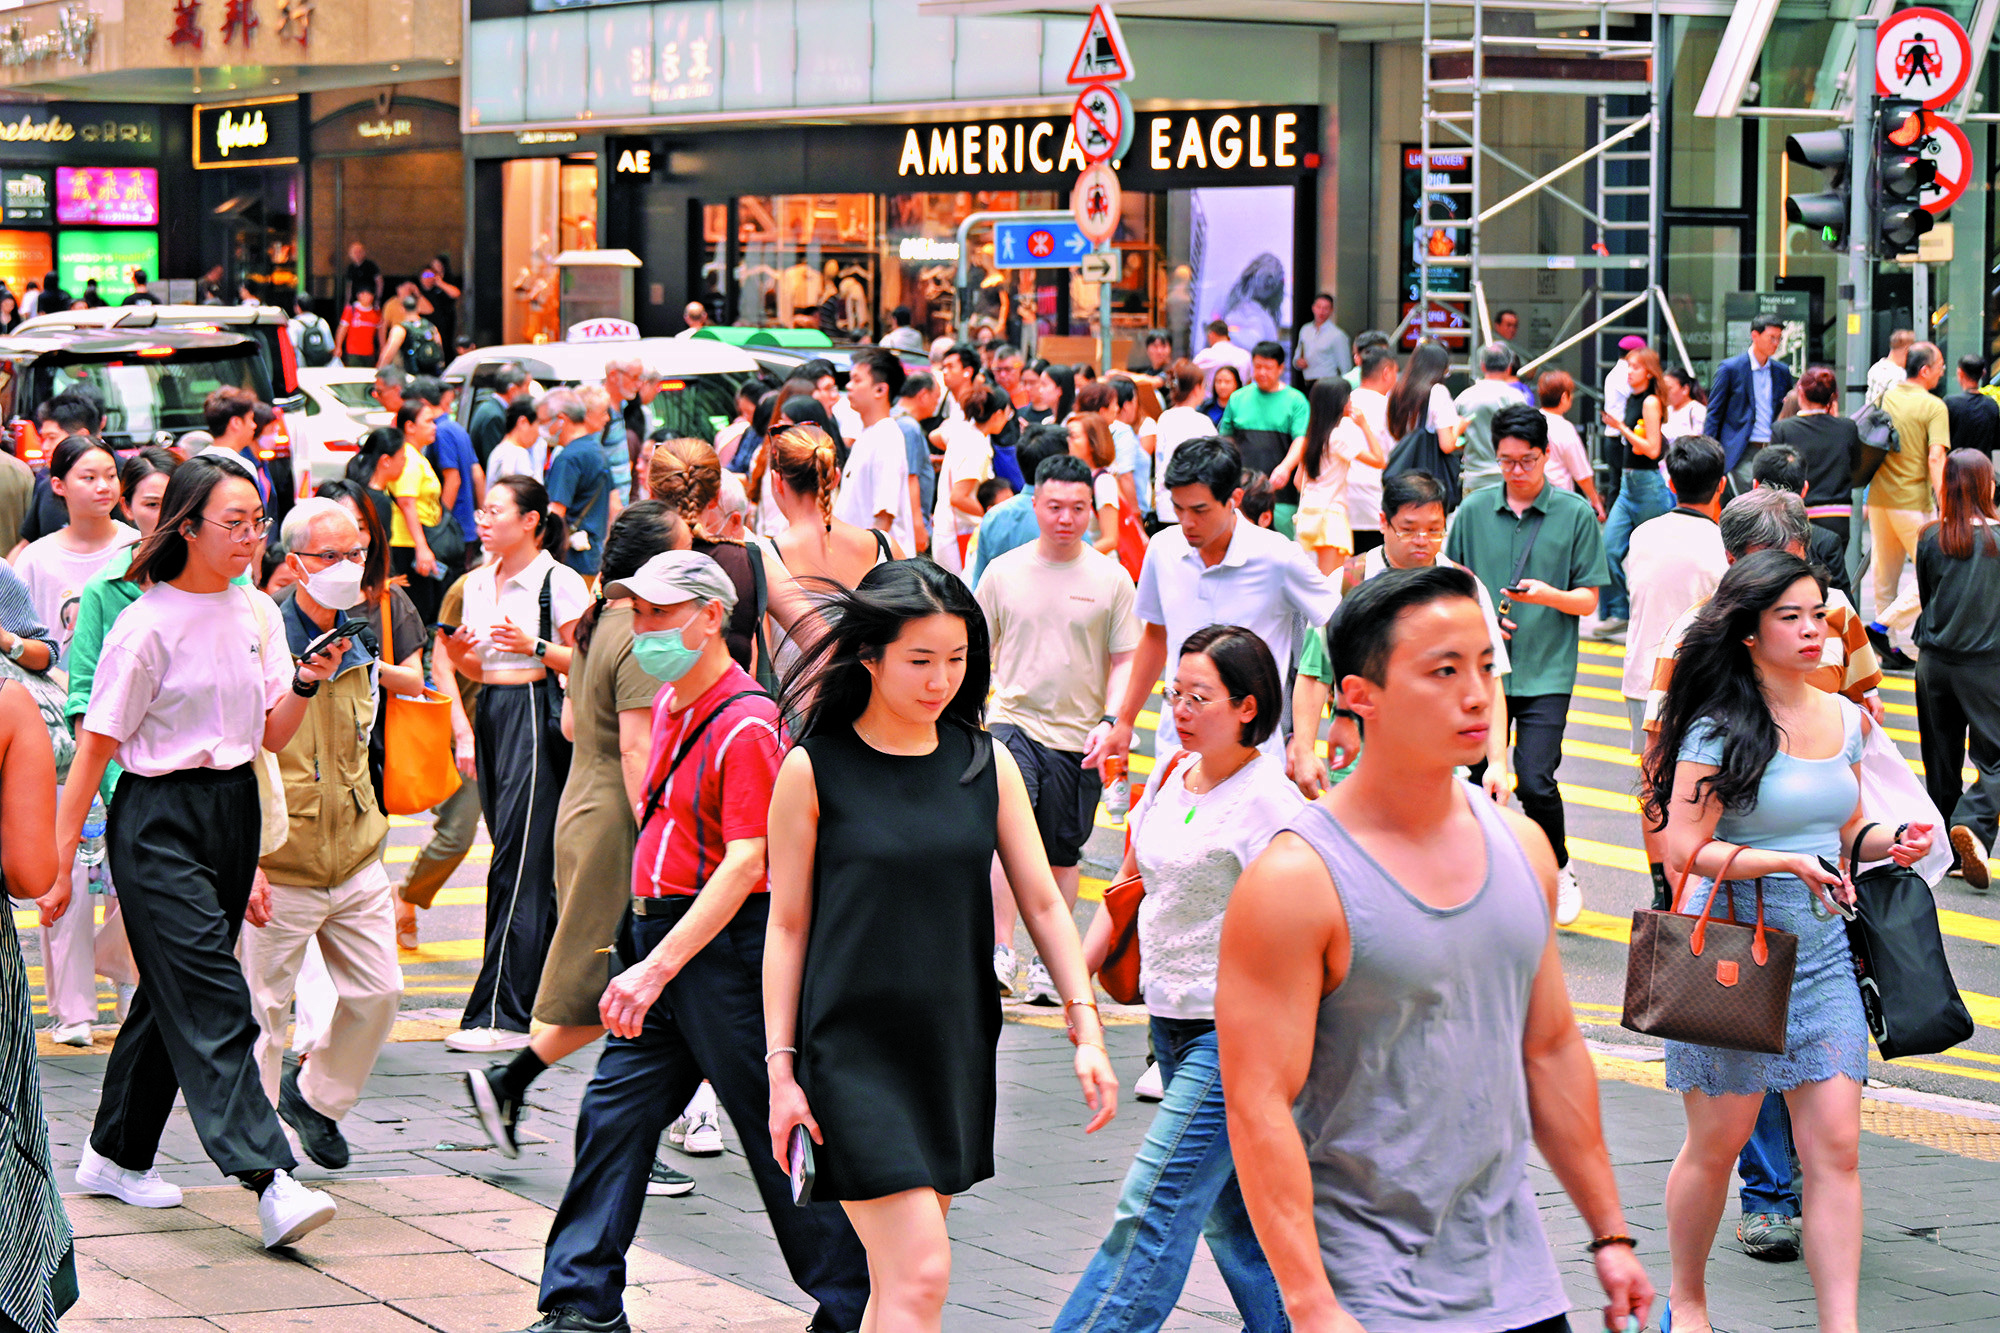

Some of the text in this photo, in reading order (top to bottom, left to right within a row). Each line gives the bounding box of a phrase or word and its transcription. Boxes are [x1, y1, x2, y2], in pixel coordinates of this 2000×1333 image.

[167, 0, 315, 50] 萬邦行
[616, 149, 652, 174] AE
[898, 112, 1298, 177] AMERICA EAGLE
[582, 323, 630, 338] TAXI
